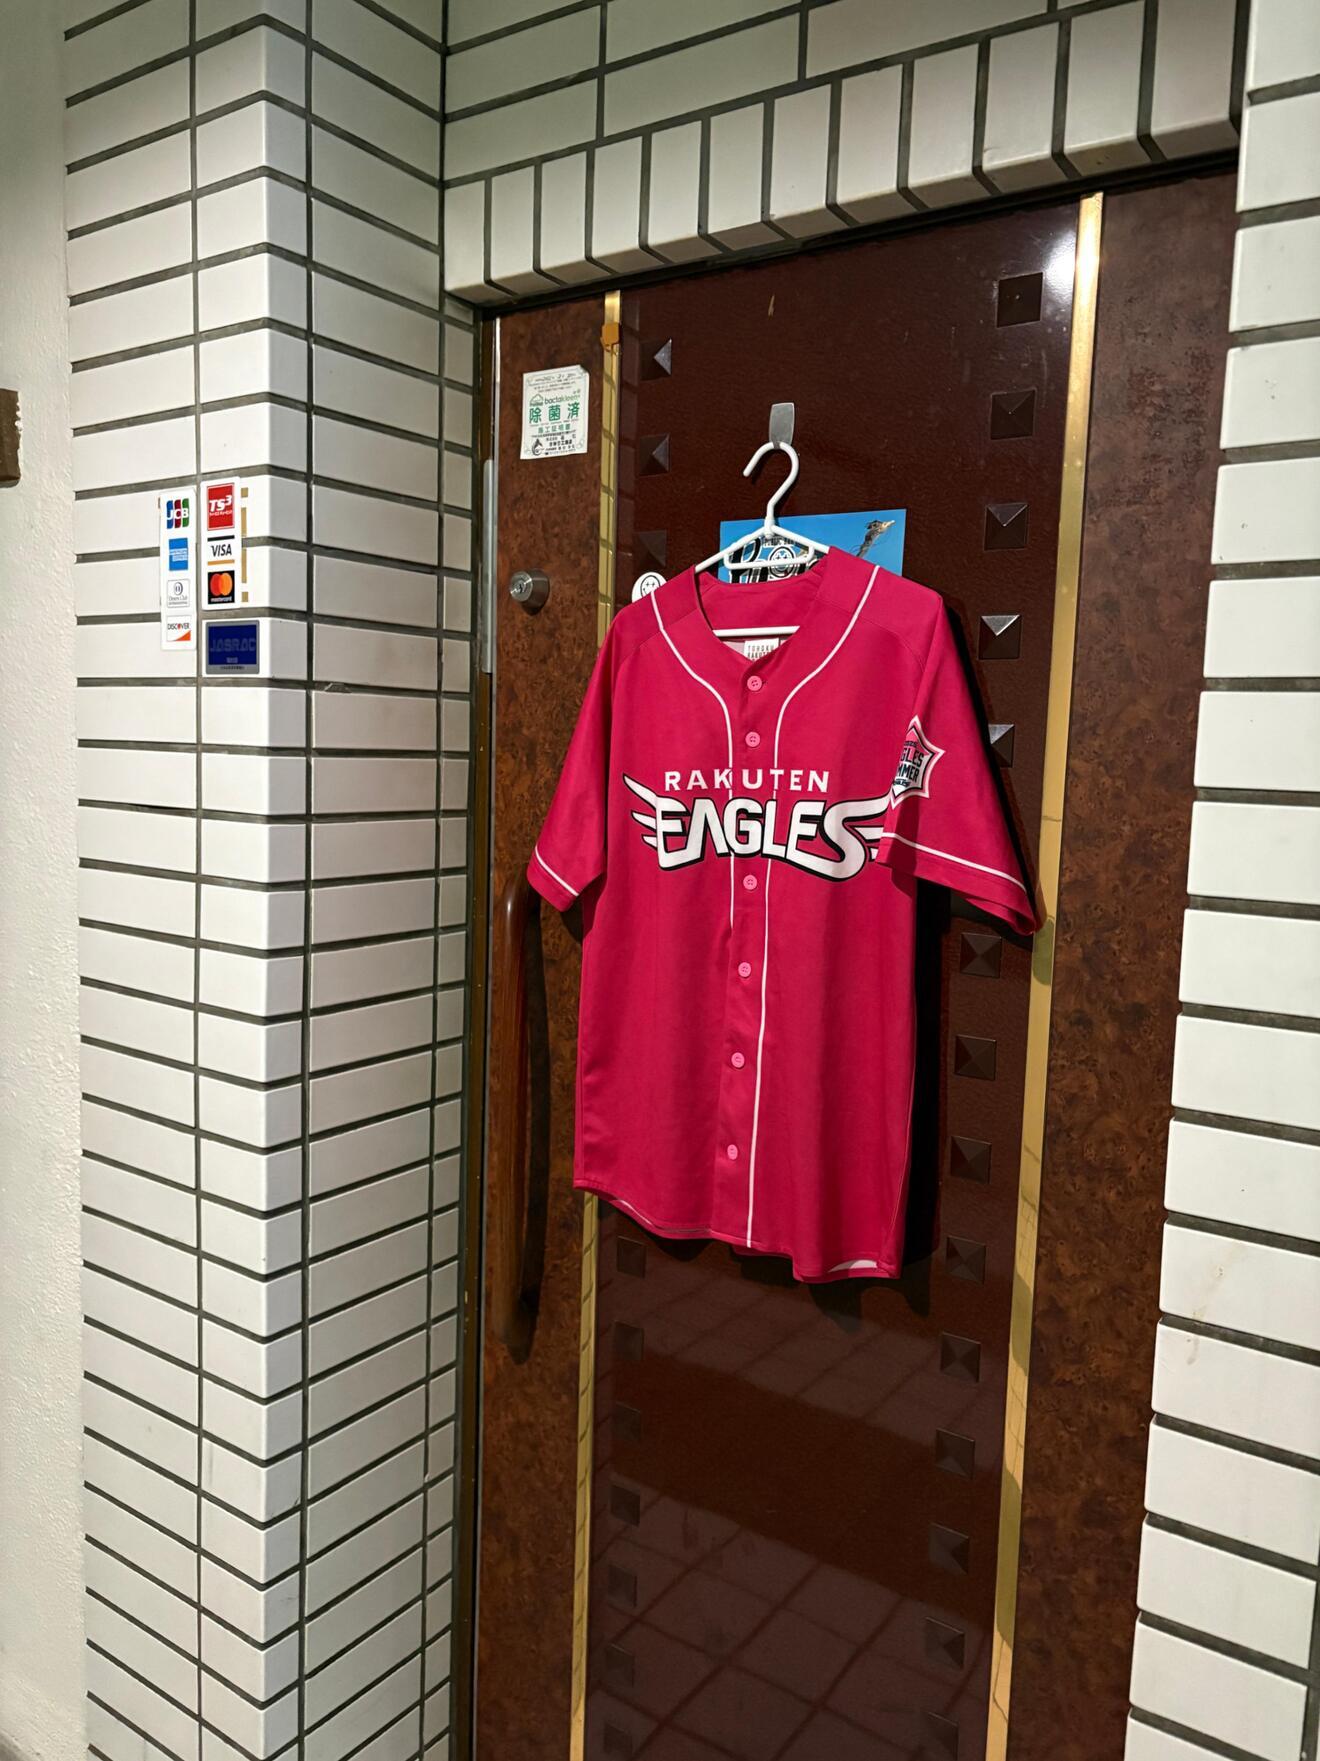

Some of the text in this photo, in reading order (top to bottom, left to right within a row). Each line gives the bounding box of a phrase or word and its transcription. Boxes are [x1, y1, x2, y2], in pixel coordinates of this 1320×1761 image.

[529, 402, 580, 424] 除菌済
[166, 508, 189, 520] JCB
[211, 544, 232, 557] VISA
[167, 622, 190, 630] DISCOVER
[209, 638, 257, 652] JASRAC
[664, 768, 830, 792] RAKUTEN
[655, 796, 890, 882] EAGLES
